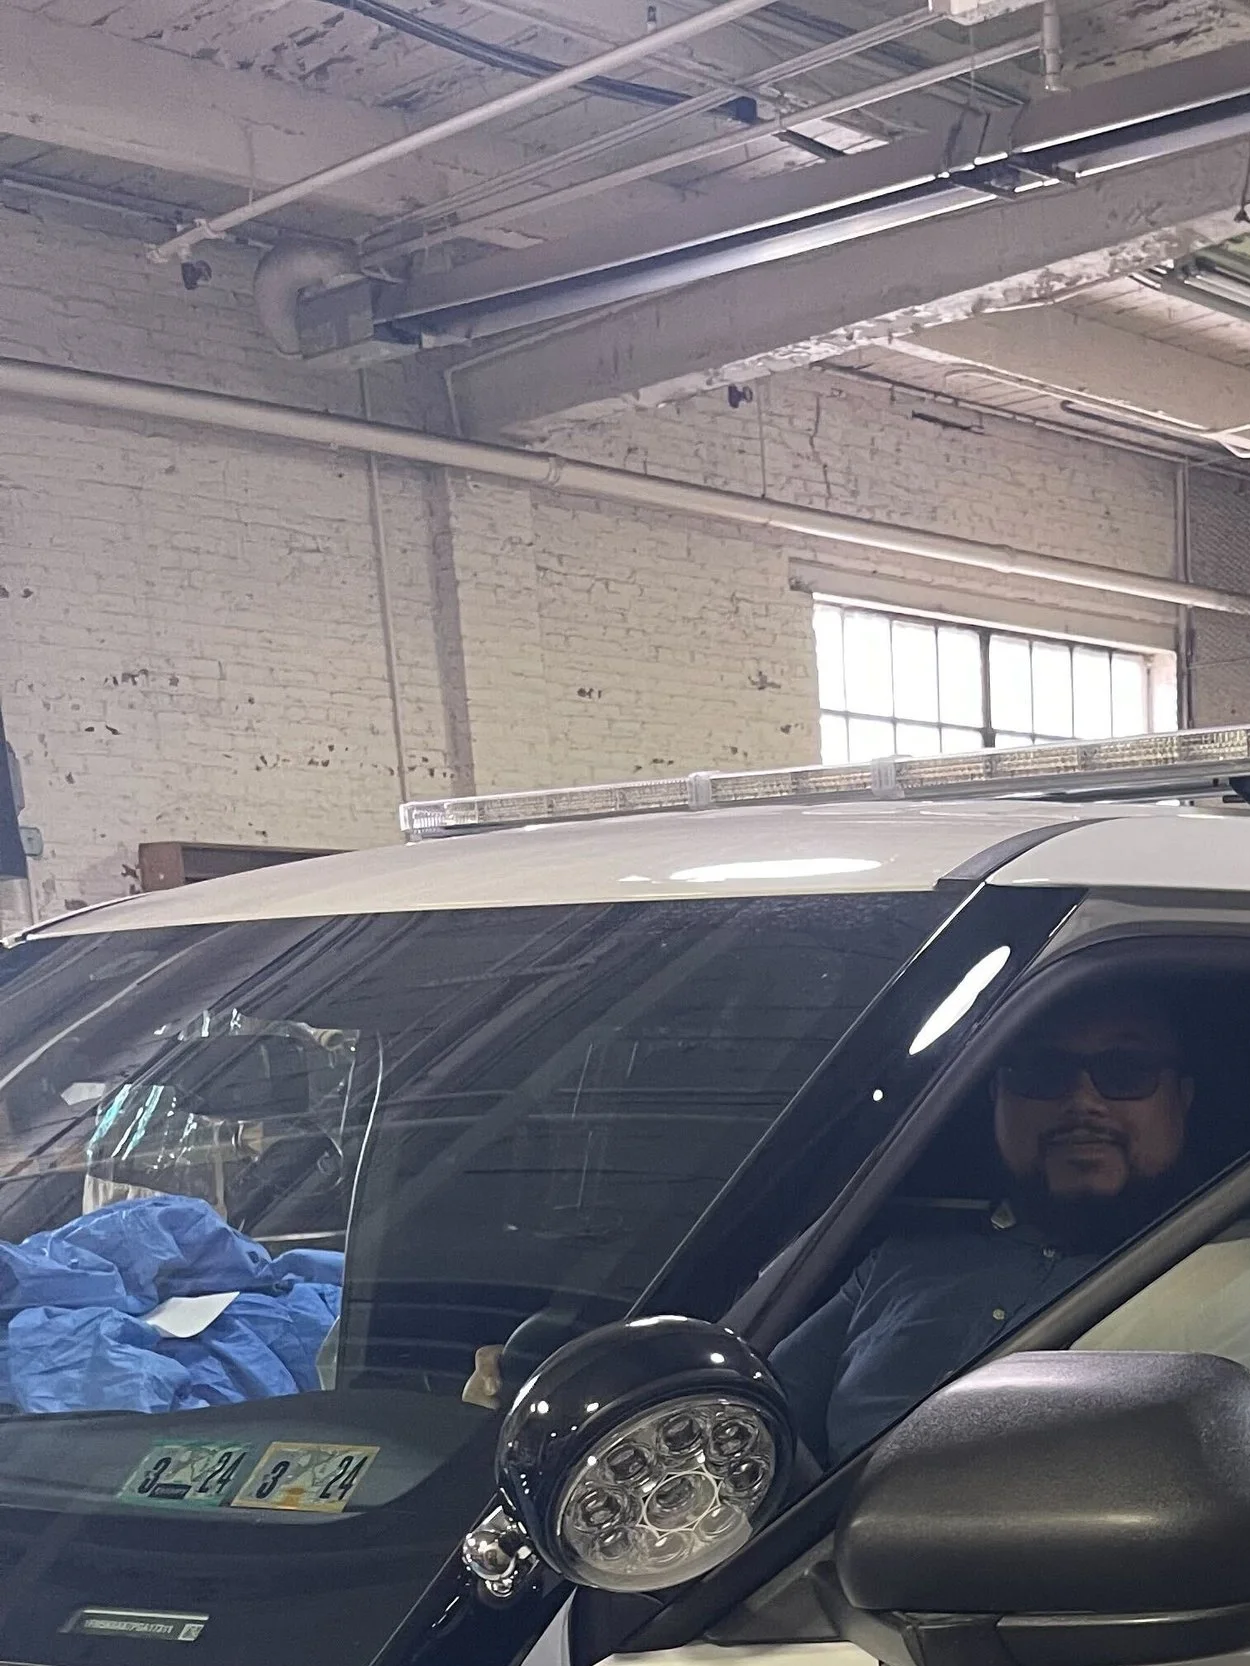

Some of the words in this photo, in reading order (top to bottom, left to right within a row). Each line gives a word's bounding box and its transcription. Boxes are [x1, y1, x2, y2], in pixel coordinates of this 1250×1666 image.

[137, 1457, 172, 1494] 3
[197, 1451, 248, 1494] 24
[255, 1460, 291, 1499] 3
[319, 1455, 368, 1500] 24
